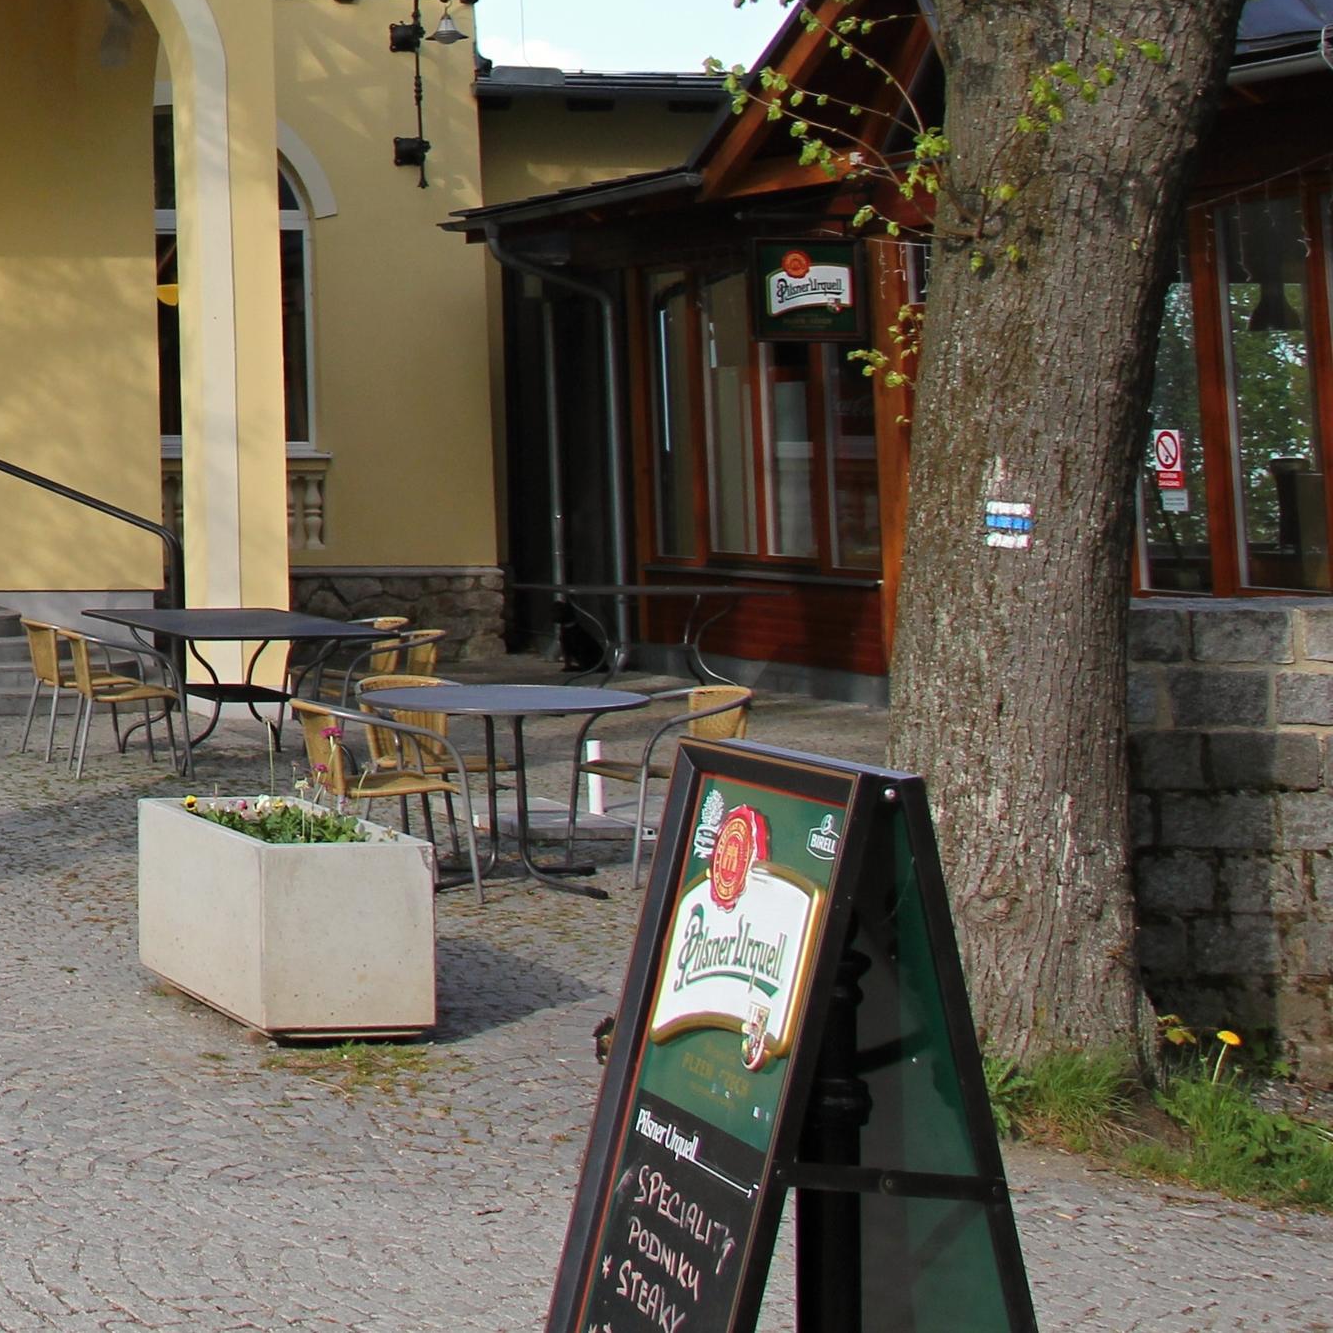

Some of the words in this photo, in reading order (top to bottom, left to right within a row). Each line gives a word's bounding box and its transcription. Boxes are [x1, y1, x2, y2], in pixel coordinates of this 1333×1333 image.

[776, 278, 810, 304] Pilsner
[809, 277, 843, 297] Urquell
[674, 903, 736, 992] Pilsner
[732, 914, 787, 993] Urquell
[635, 1108, 667, 1144] Pilsner
[665, 1123, 700, 1161] Urquell
